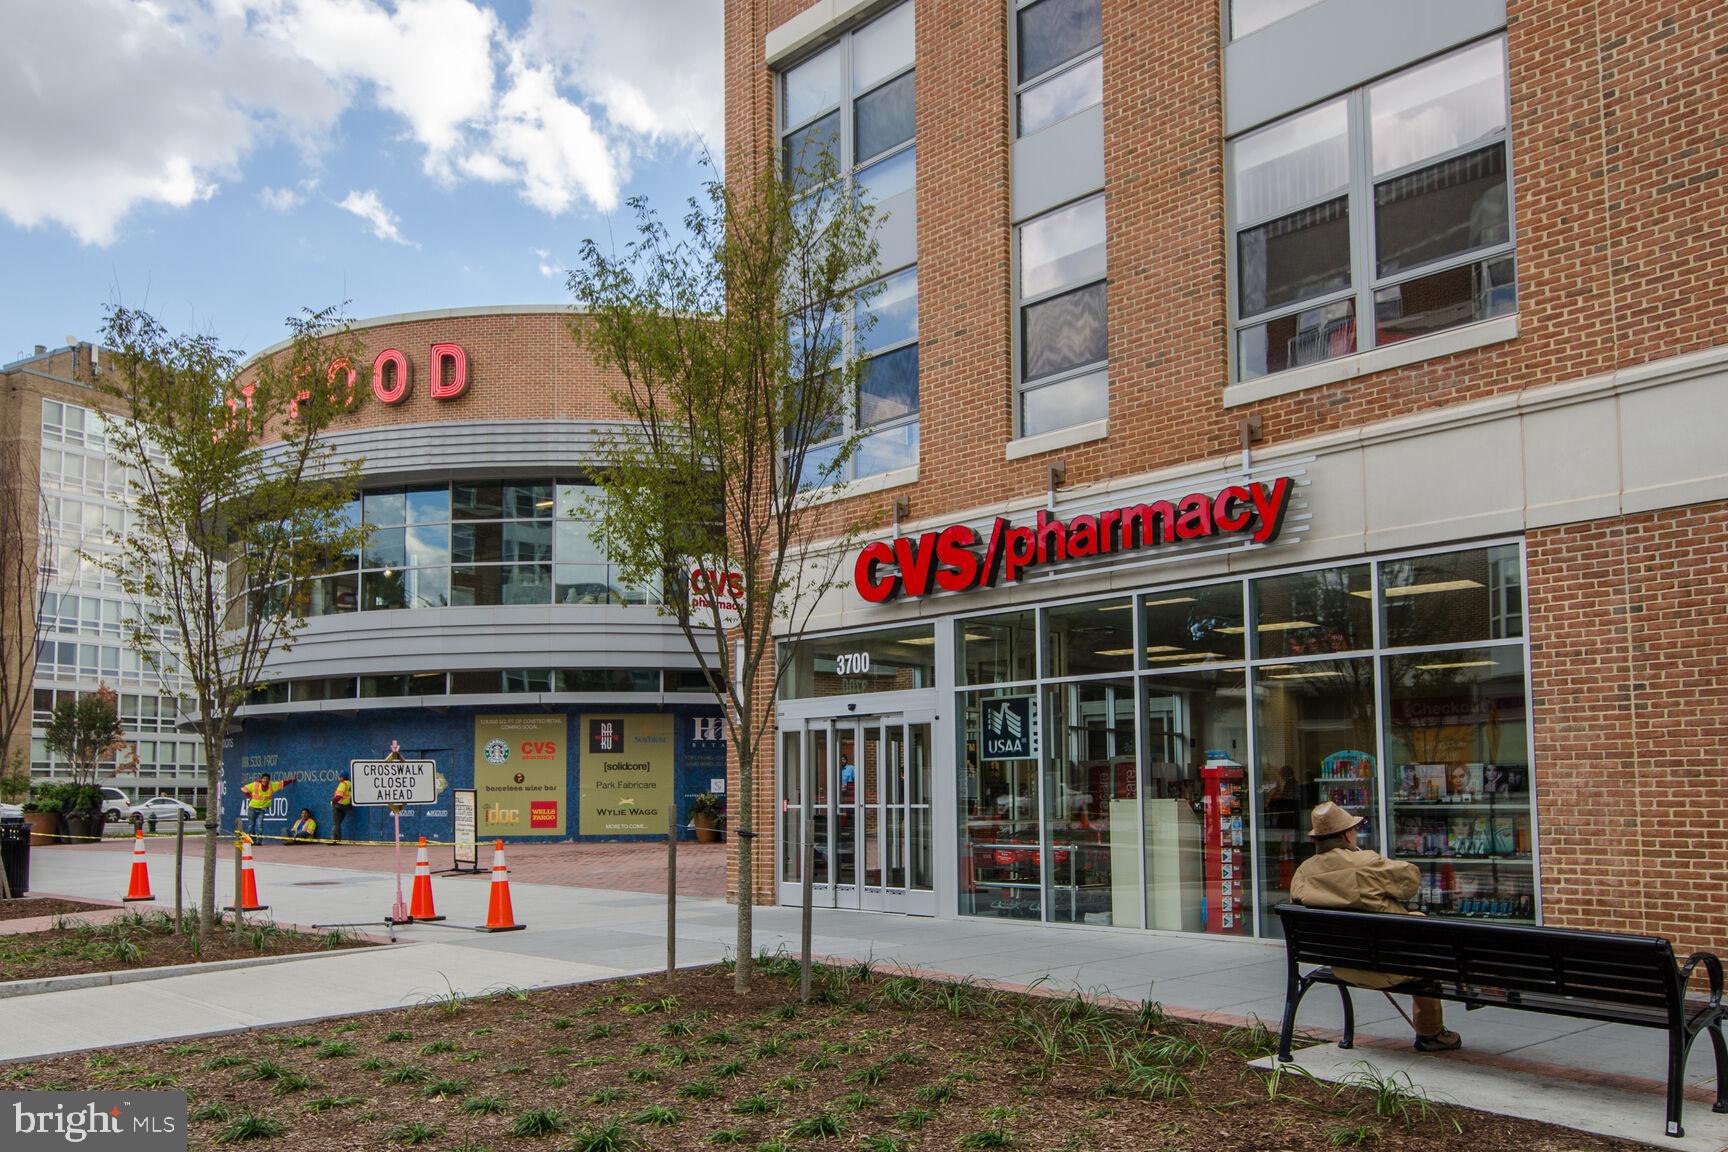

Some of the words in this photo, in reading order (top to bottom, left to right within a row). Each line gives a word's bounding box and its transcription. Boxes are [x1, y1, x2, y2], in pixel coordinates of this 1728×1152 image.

[854, 476, 1295, 604] CVS/pharmacy
[691, 569, 744, 599] CVS
[692, 598, 743, 612] phamac
[836, 652, 870, 676] 3700
[521, 741, 556, 755] CVS
[988, 739, 1022, 754] USAA
[363, 764, 424, 776] CROSSWALK
[603, 761, 650, 773] [solidcore]
[373, 777, 416, 789] CLOSED
[596, 781, 616, 789] Park
[617, 781, 657, 789] Fabricare
[377, 789, 413, 800] AHEAD
[597, 808, 627, 816] WYLIE
[629, 808, 658, 816] WAGG
